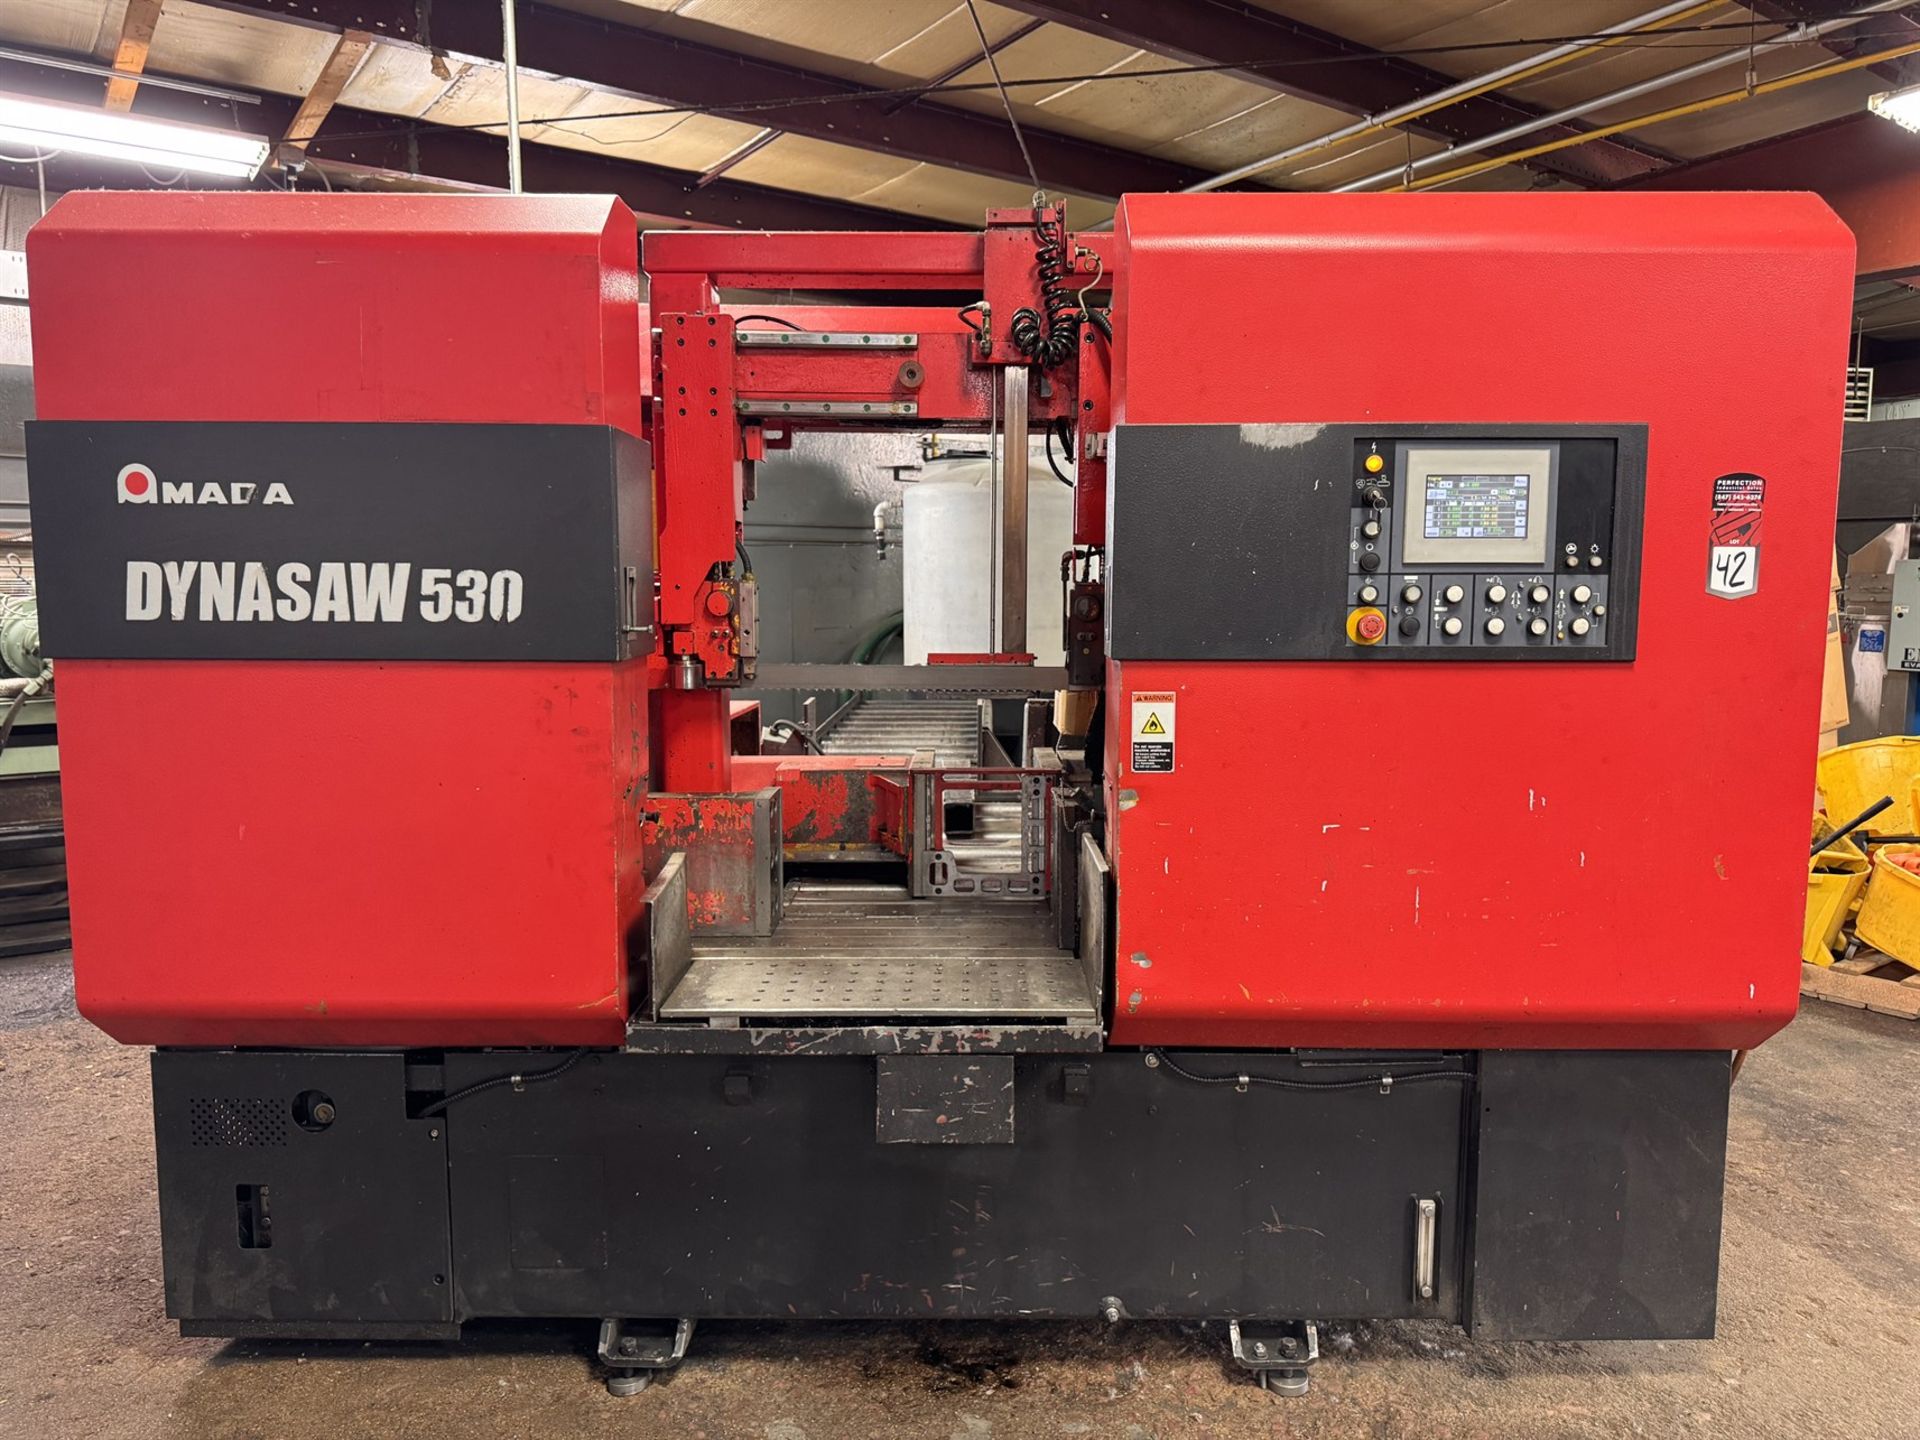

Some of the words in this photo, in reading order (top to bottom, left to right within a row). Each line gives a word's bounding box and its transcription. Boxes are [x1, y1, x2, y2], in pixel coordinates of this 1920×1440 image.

[117, 463, 295, 505] AMADA
[1716, 551, 1747, 588] 42
[126, 561, 411, 622] DYNASAW
[419, 569, 523, 623] 530
